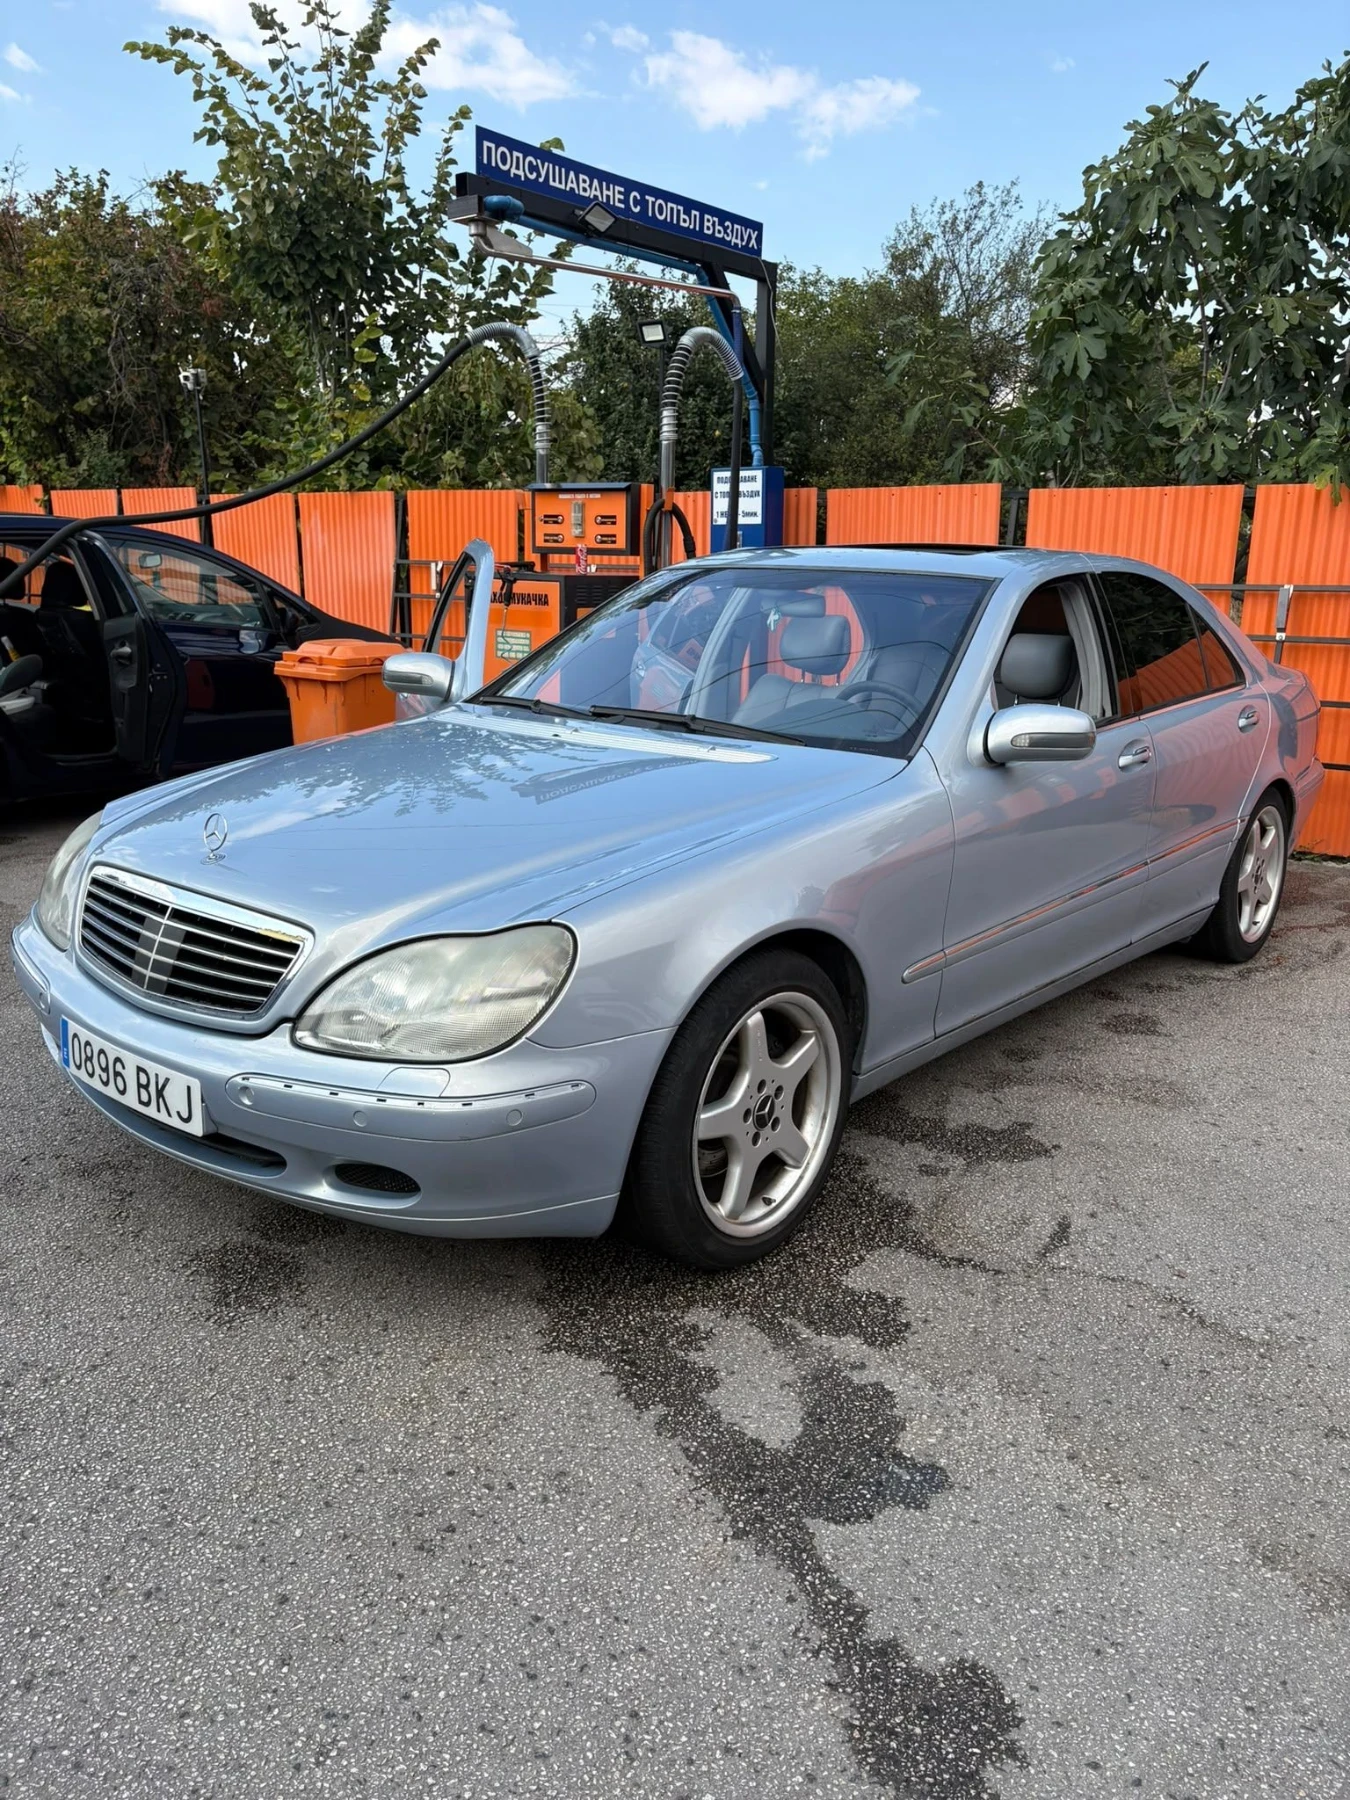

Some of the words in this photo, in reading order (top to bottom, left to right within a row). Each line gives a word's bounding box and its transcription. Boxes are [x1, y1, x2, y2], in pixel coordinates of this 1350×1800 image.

[482, 140, 625, 209] ПОДСУШАВАНЕ
[629, 190, 641, 214] С
[644, 194, 700, 232] ТОПЪЛ
[703, 213, 759, 250] ВЪЗДУХ
[71, 1032, 127, 1096] 0896
[136, 1065, 193, 1124] BKJ
